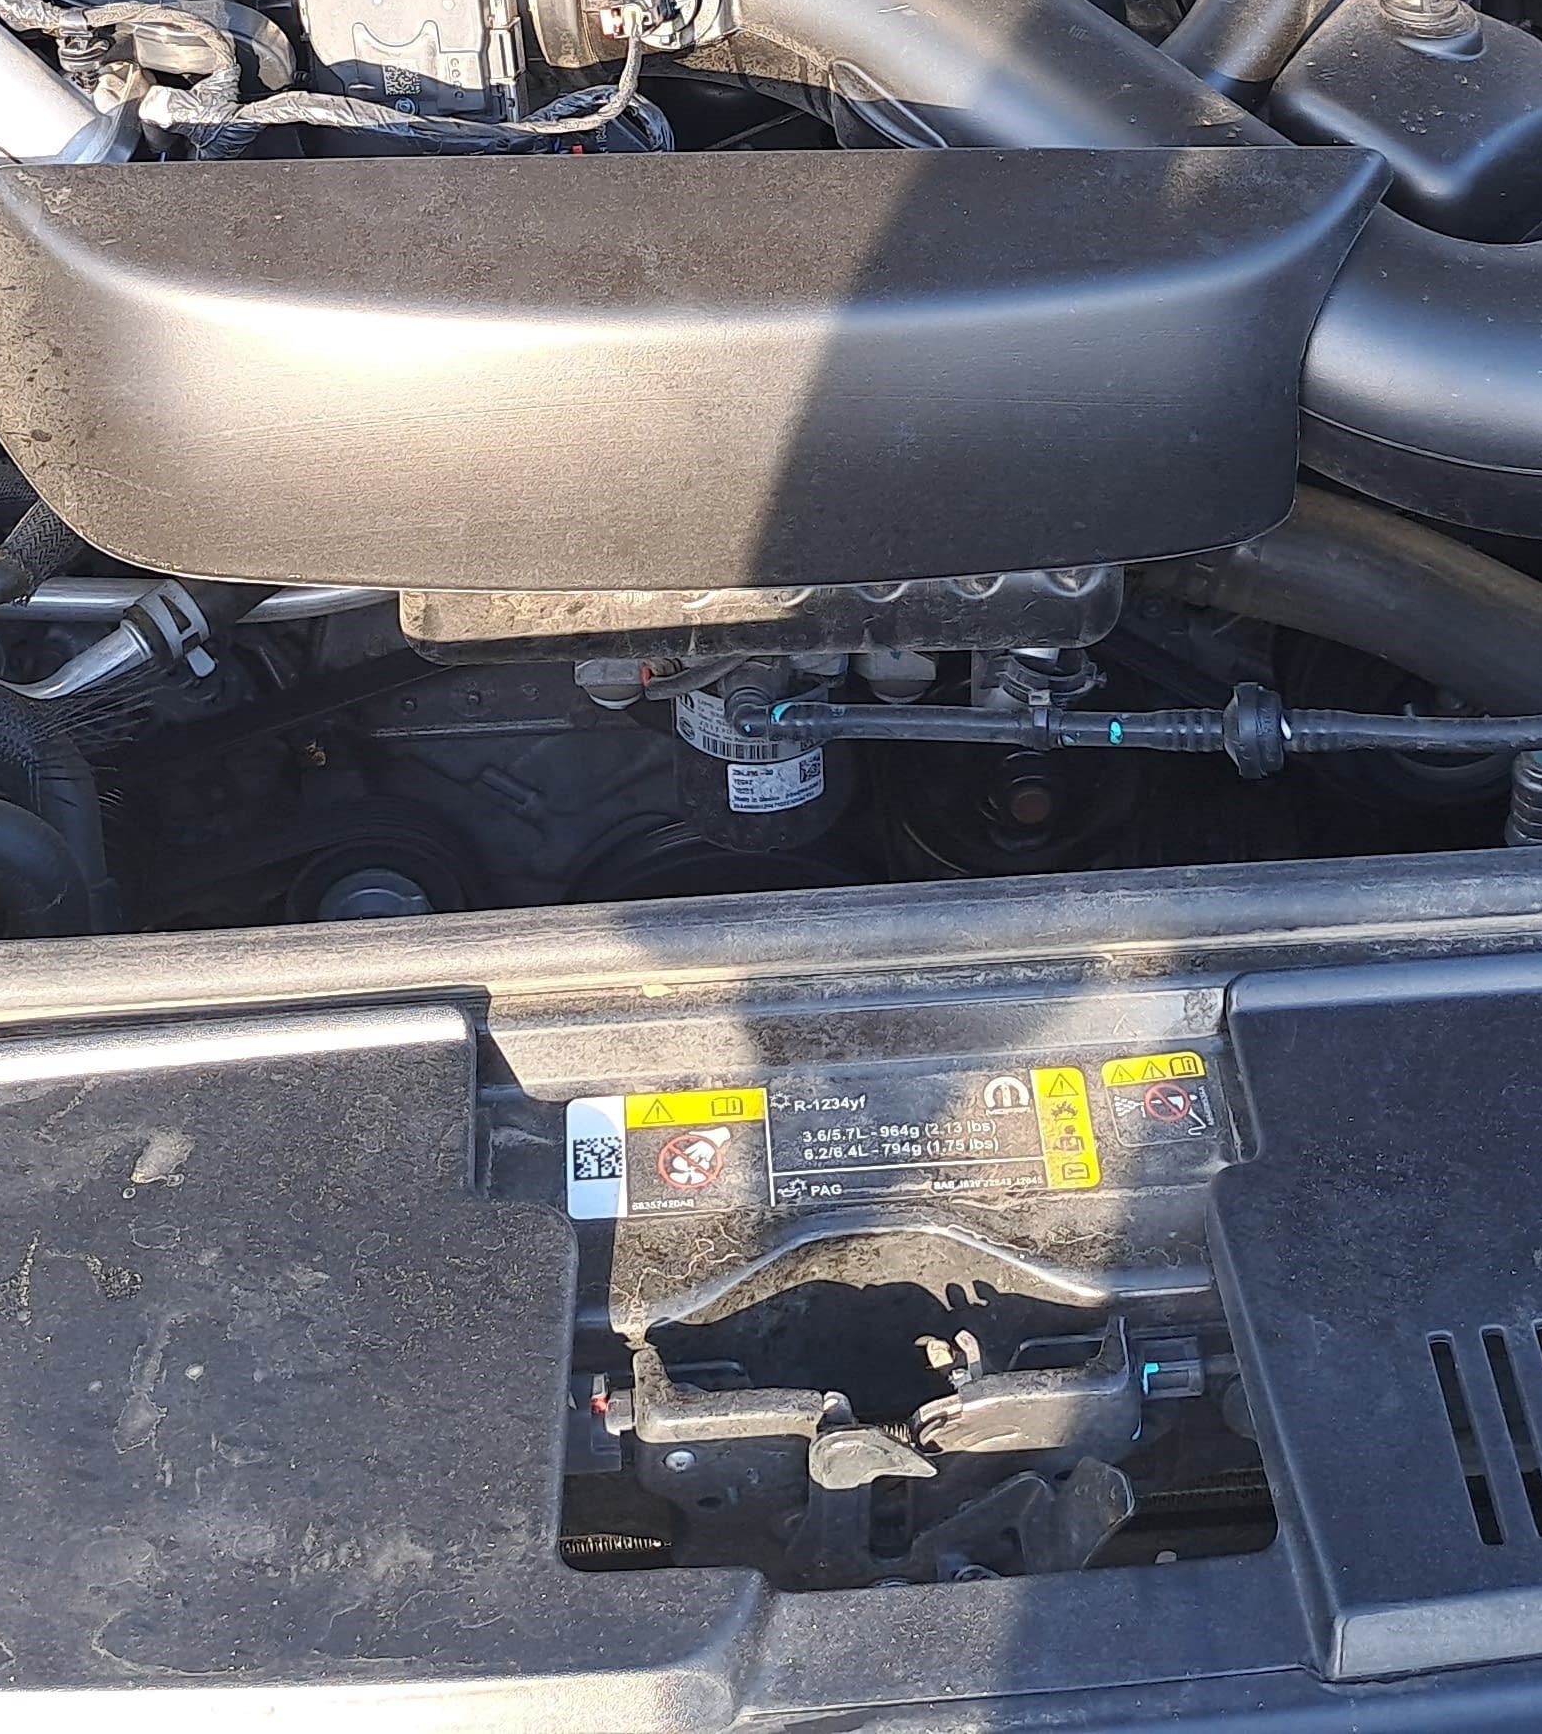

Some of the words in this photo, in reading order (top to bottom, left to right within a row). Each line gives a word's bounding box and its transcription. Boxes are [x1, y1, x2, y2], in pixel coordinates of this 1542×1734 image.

[792, 1093, 868, 1114] R-1234yf
[801, 1126, 868, 1144] 3.6/5.7L
[879, 1124, 921, 1141] 964g
[924, 1120, 964, 1138] (2.13
[966, 1118, 998, 1136] lbs)
[803, 1143, 869, 1162] 6.2/6.4L
[880, 1141, 923, 1158] 794g
[926, 1137, 965, 1155] (1.75
[968, 1136, 1000, 1153] lbs)
[810, 1184, 843, 1198] PAG
